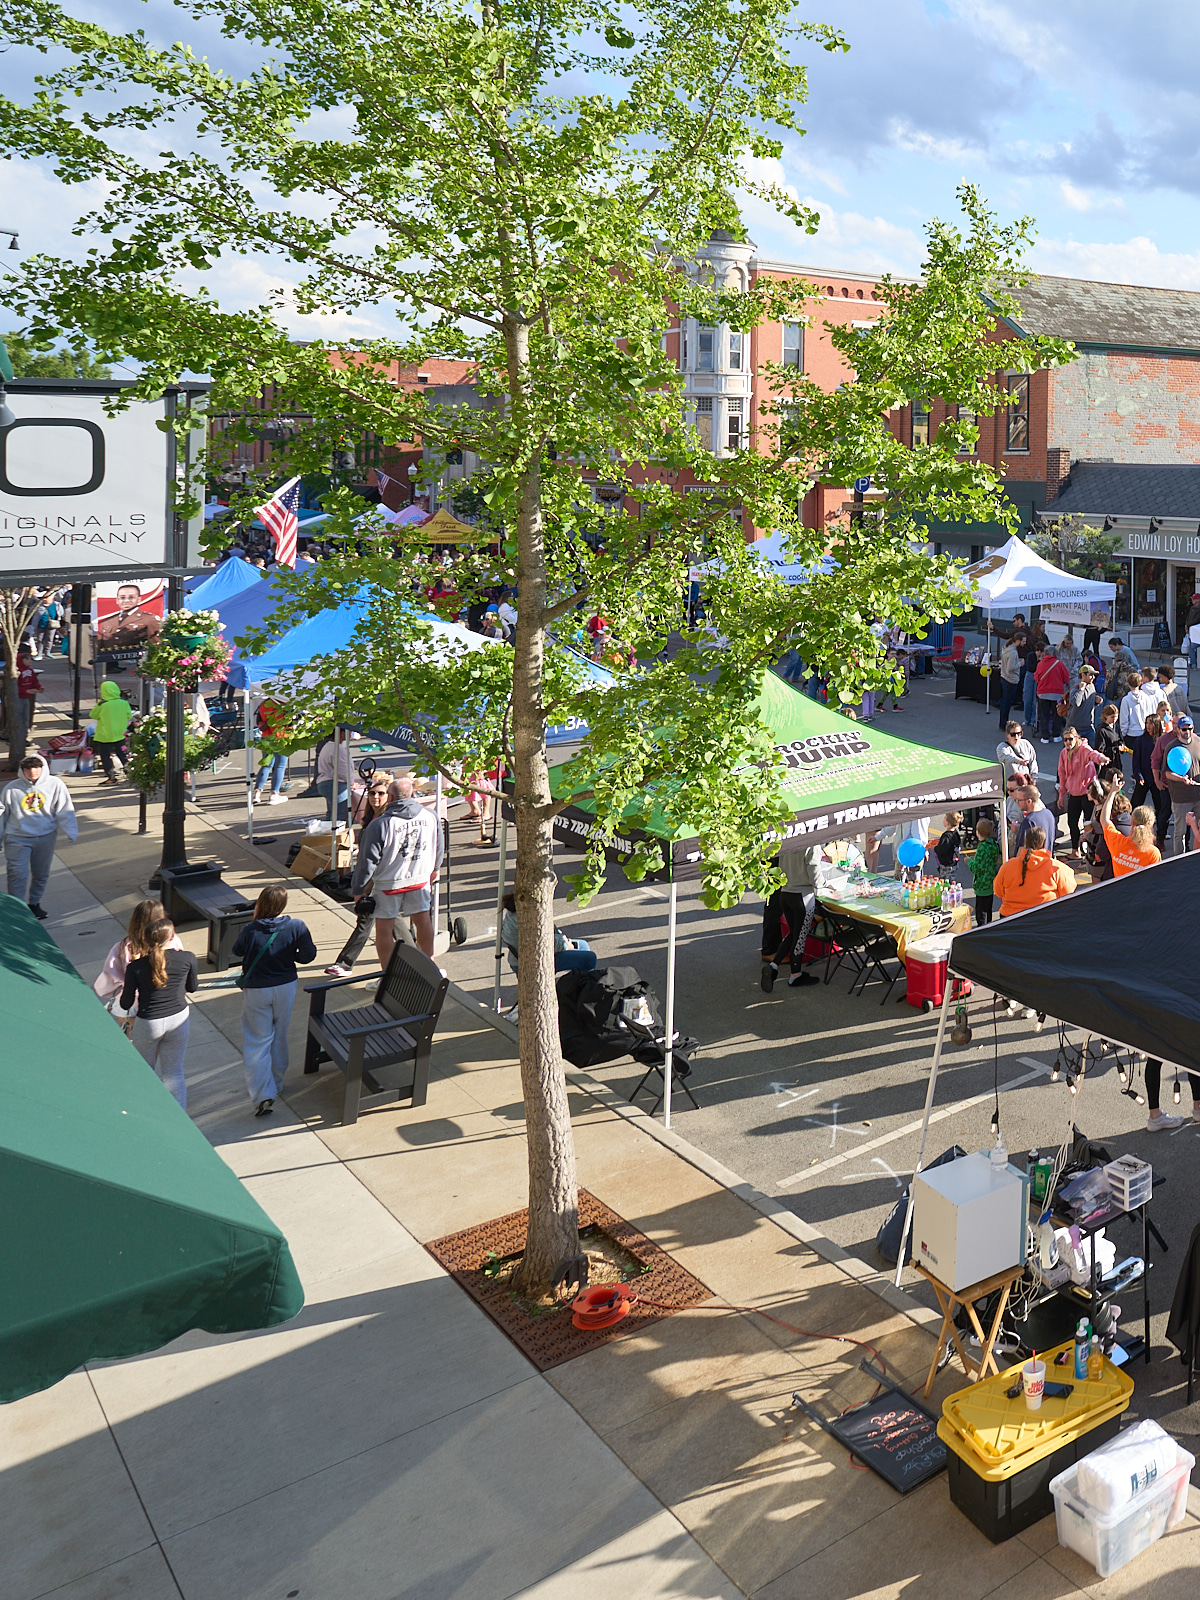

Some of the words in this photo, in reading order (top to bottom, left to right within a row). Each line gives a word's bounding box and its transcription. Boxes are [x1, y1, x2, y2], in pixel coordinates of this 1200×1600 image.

[859, 478, 868, 491] P
[0, 531, 146, 548] COMPANY
[1128, 533, 1161, 551] EDWIN
[1164, 535, 1183, 553] LOY
[1019, 592, 1044, 601] CALLED
[1045, 591, 1054, 599] TO
[1056, 589, 1088, 598] HOLINESS
[1073, 602, 1089, 612] PAUL
[773, 731, 861, 754] ROCKIN'
[785, 741, 871, 769] JUMP
[833, 791, 947, 826] TRAMPOLINE
[949, 779, 999, 800] PARK.
[1119, 852, 1141, 864] TEAM
[1028, 1384, 1044, 1394] GULP
[1031, 1379, 1043, 1388] BIG
